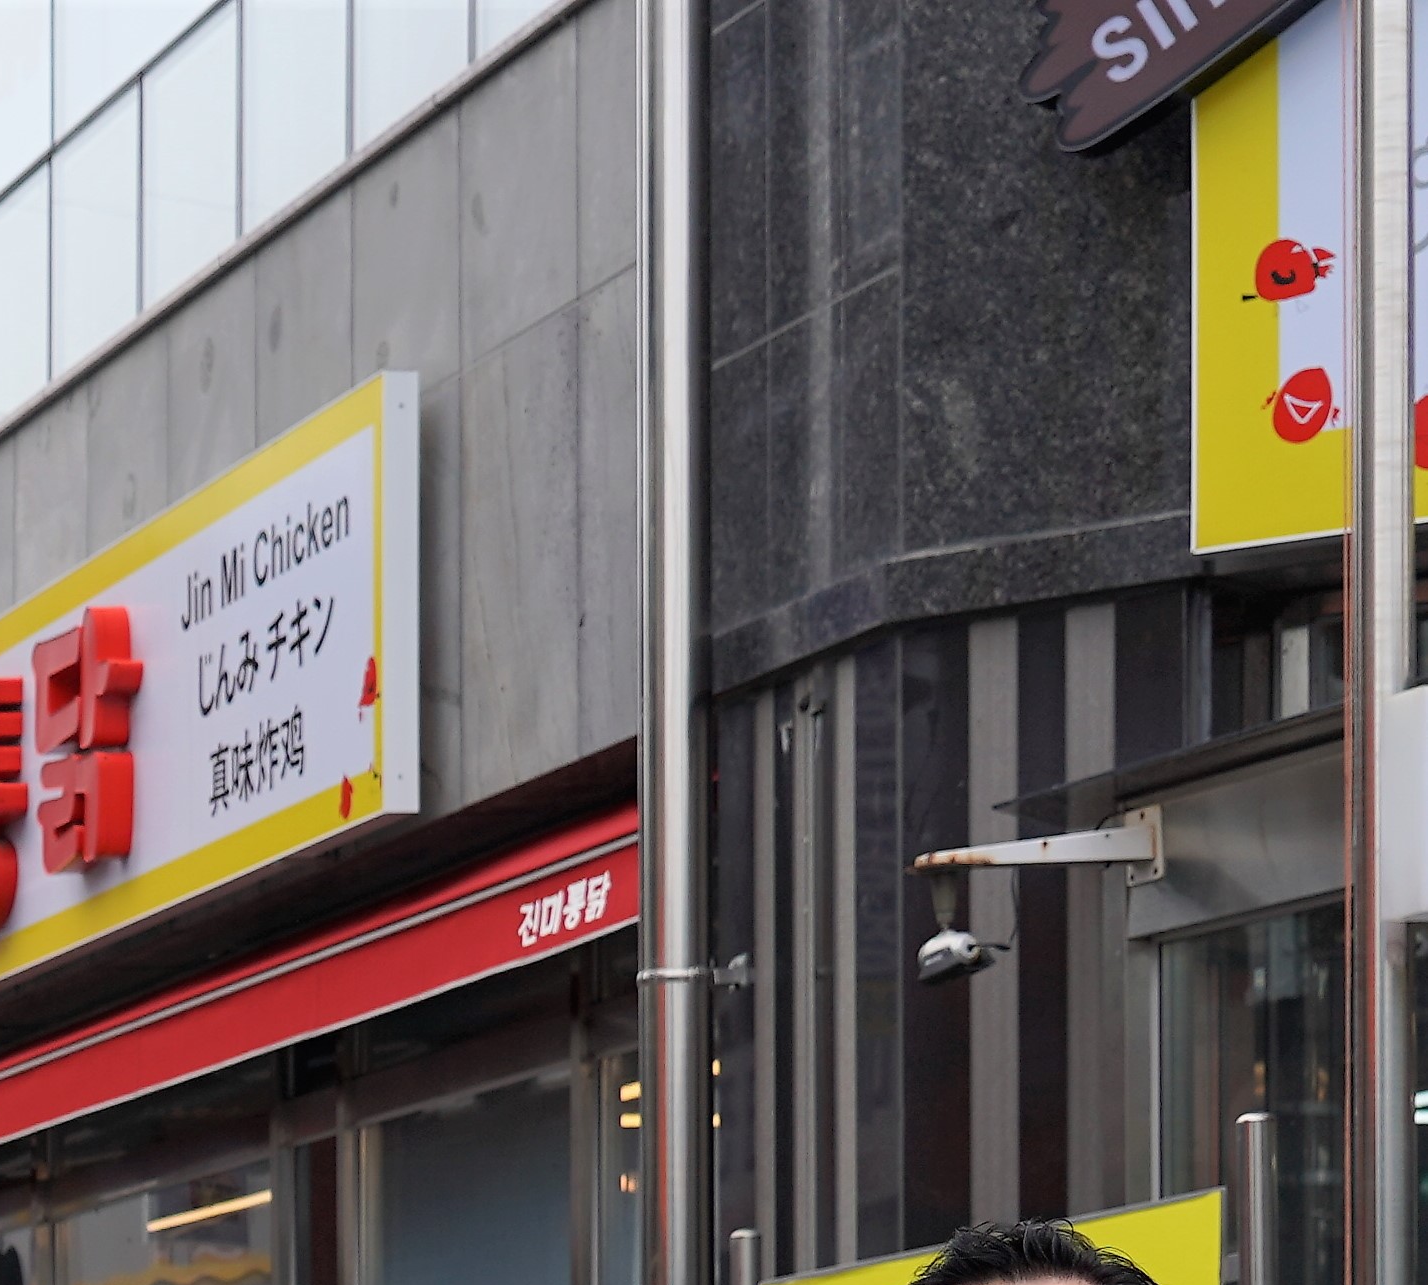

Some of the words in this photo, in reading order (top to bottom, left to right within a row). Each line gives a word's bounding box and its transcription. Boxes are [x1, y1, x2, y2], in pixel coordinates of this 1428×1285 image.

[180, 570, 213, 632] Jin
[220, 542, 245, 609] Mi
[253, 495, 350, 587] Chicken
[517, 871, 612, 948] 진미통닭
